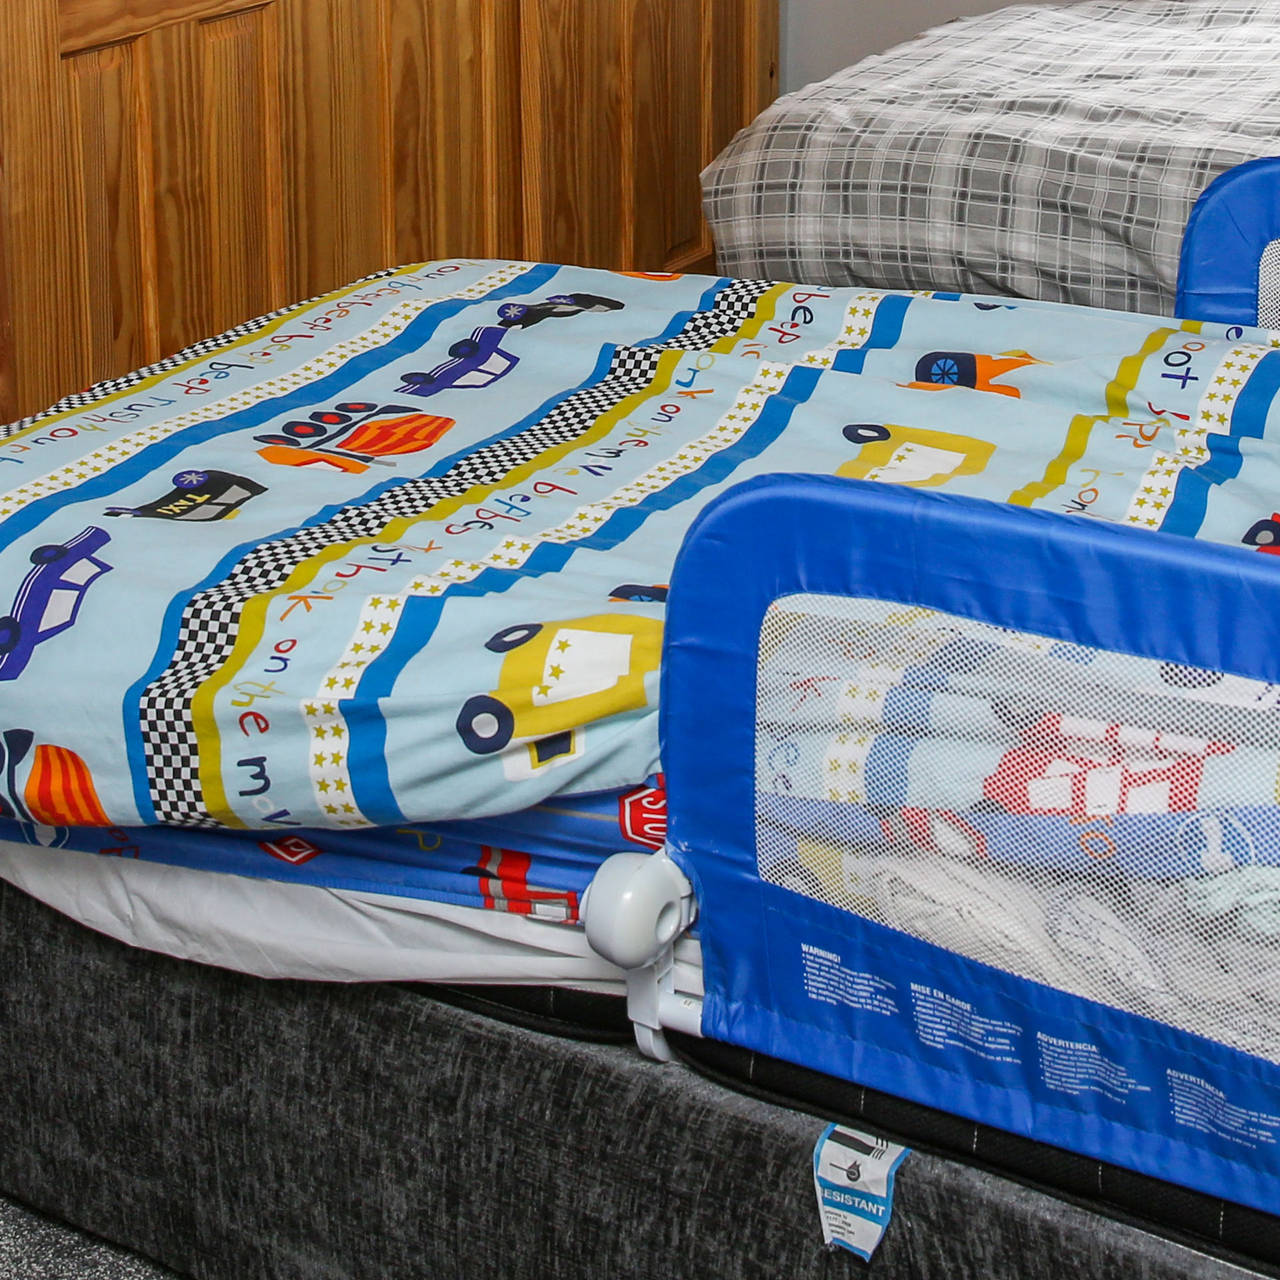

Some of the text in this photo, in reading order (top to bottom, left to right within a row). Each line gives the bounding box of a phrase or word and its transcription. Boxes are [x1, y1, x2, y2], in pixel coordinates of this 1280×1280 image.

[303, 301, 373, 331] beep
[172, 361, 255, 395] beep
[10, 422, 109, 454] hour
[264, 639, 298, 673] on
[231, 681, 286, 737] the
[236, 755, 301, 830] mov
[801, 942, 841, 964] WARNING!
[910, 981, 932, 996] MISE
[933, 988, 945, 1000] EN
